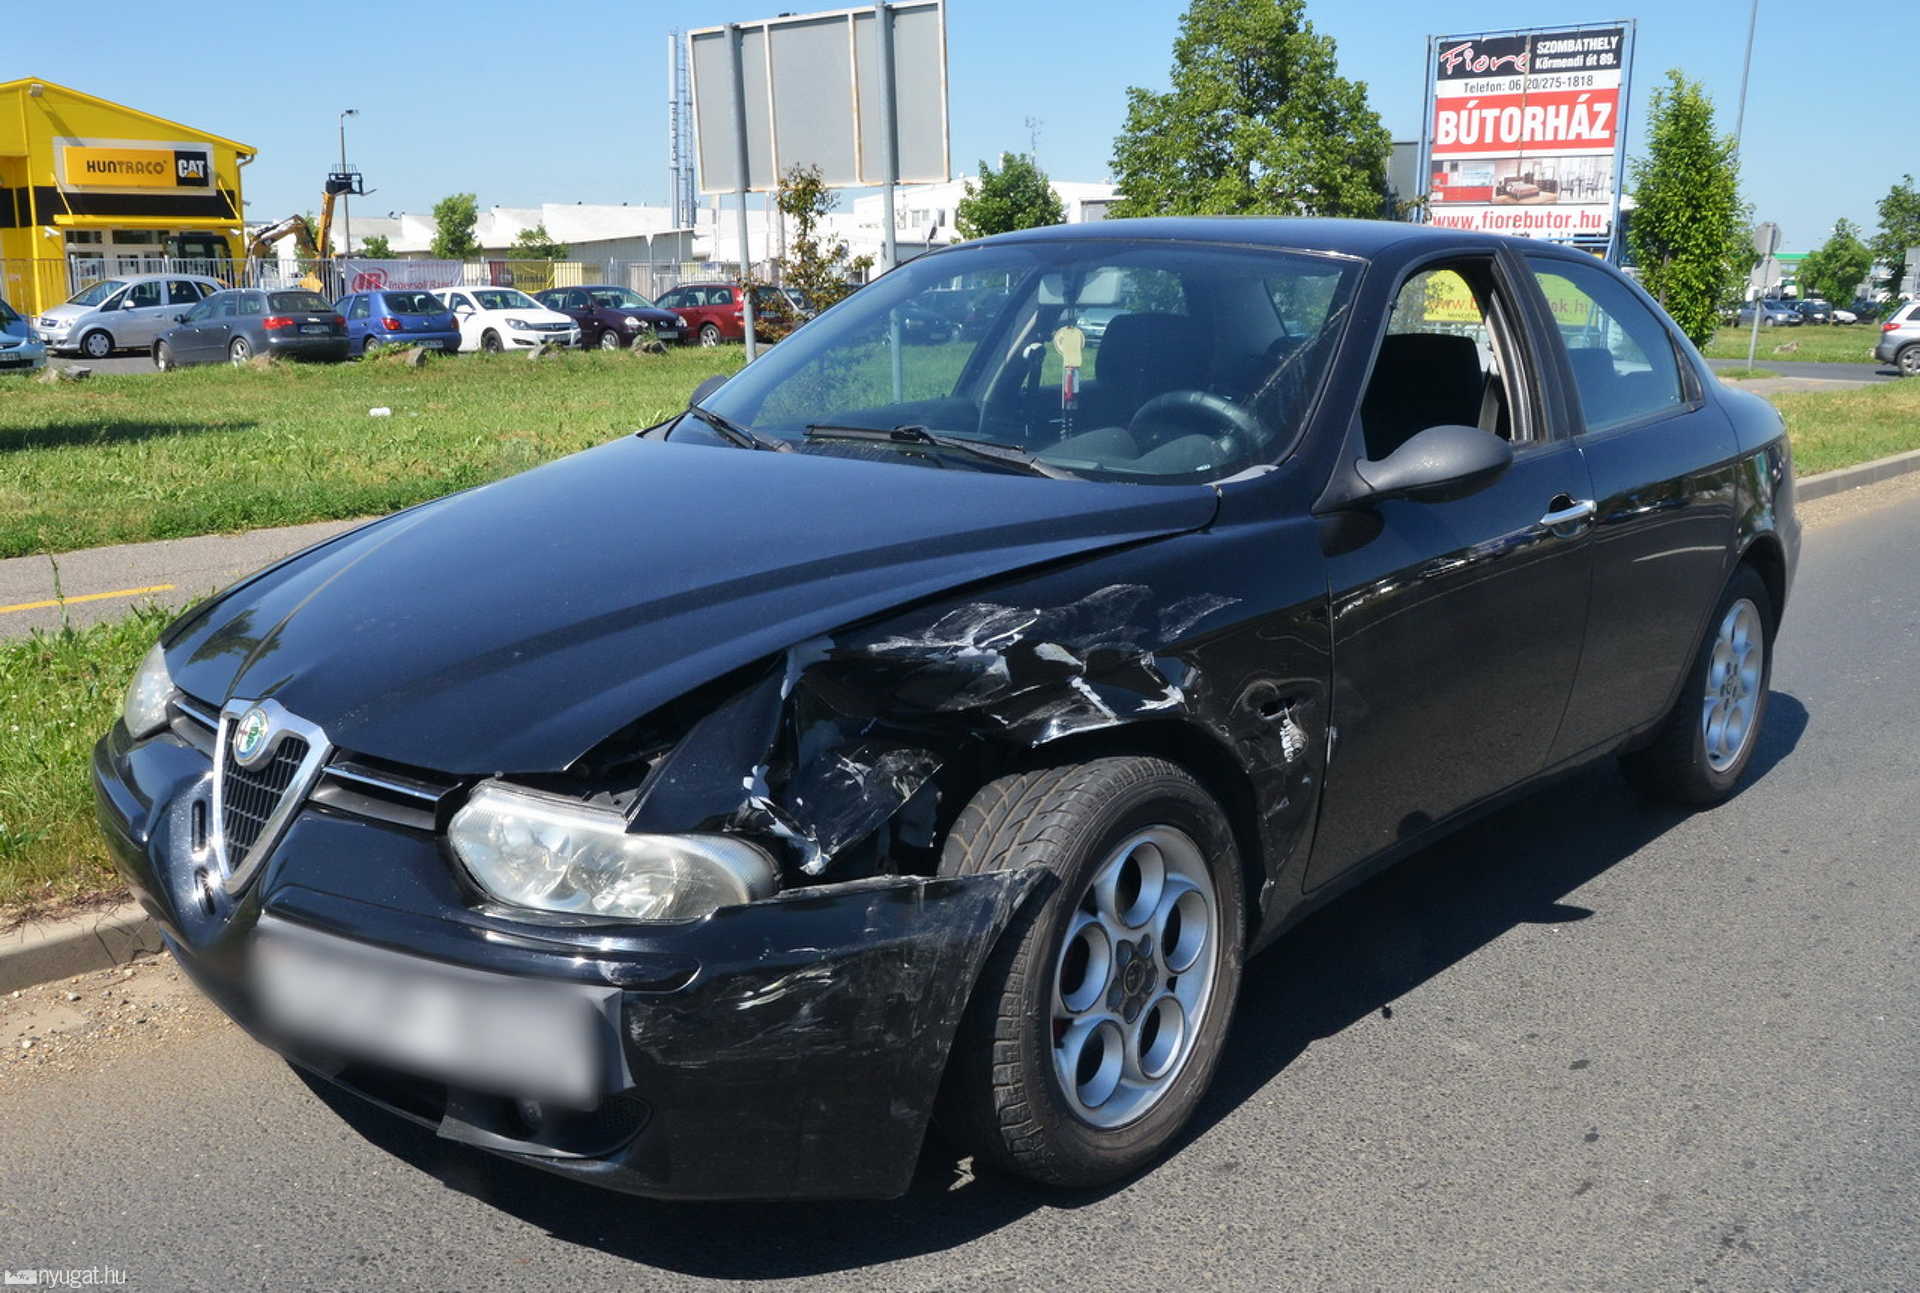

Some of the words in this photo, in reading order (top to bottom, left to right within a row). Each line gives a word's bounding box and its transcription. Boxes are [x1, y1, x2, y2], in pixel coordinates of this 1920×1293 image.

[1536, 35, 1619, 55] SZOMBATHELY
[1439, 41, 1530, 76] Fiore
[1535, 54, 1584, 70] Körmendi
[1585, 53, 1597, 67] út
[1463, 81, 1506, 94] Telefon:
[1508, 79, 1522, 92] 06
[1526, 74, 1594, 91] 20/275-1818
[1436, 93, 1613, 145] BÚTORHÁZ
[86, 159, 165, 175] HUNTRACO
[177, 158, 206, 179] CAT
[1432, 210, 1602, 231] www.fiorebutor.hu
